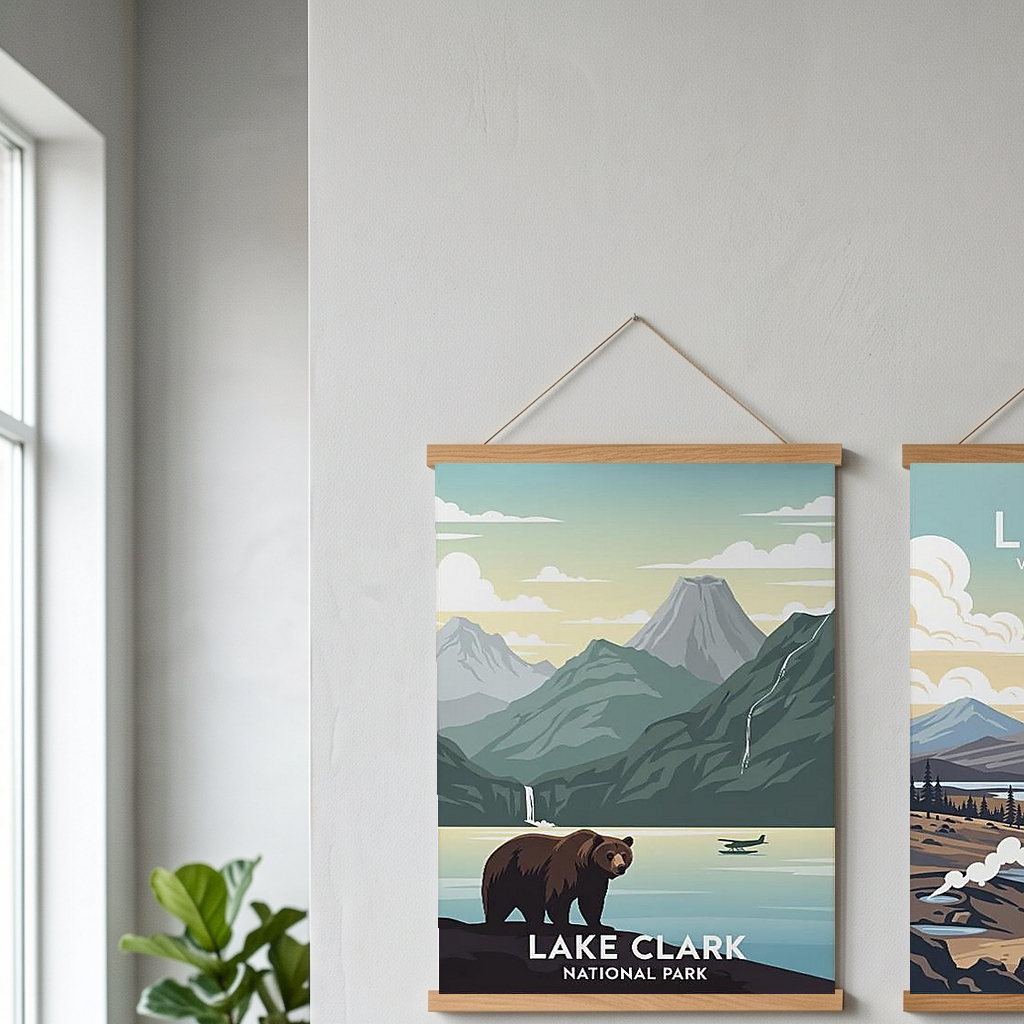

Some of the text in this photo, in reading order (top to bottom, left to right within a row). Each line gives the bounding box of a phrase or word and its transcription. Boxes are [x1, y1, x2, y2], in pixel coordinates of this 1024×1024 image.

[529, 934, 747, 960] LAKE CLARK
[563, 966, 708, 981] NATIONAL PARK
